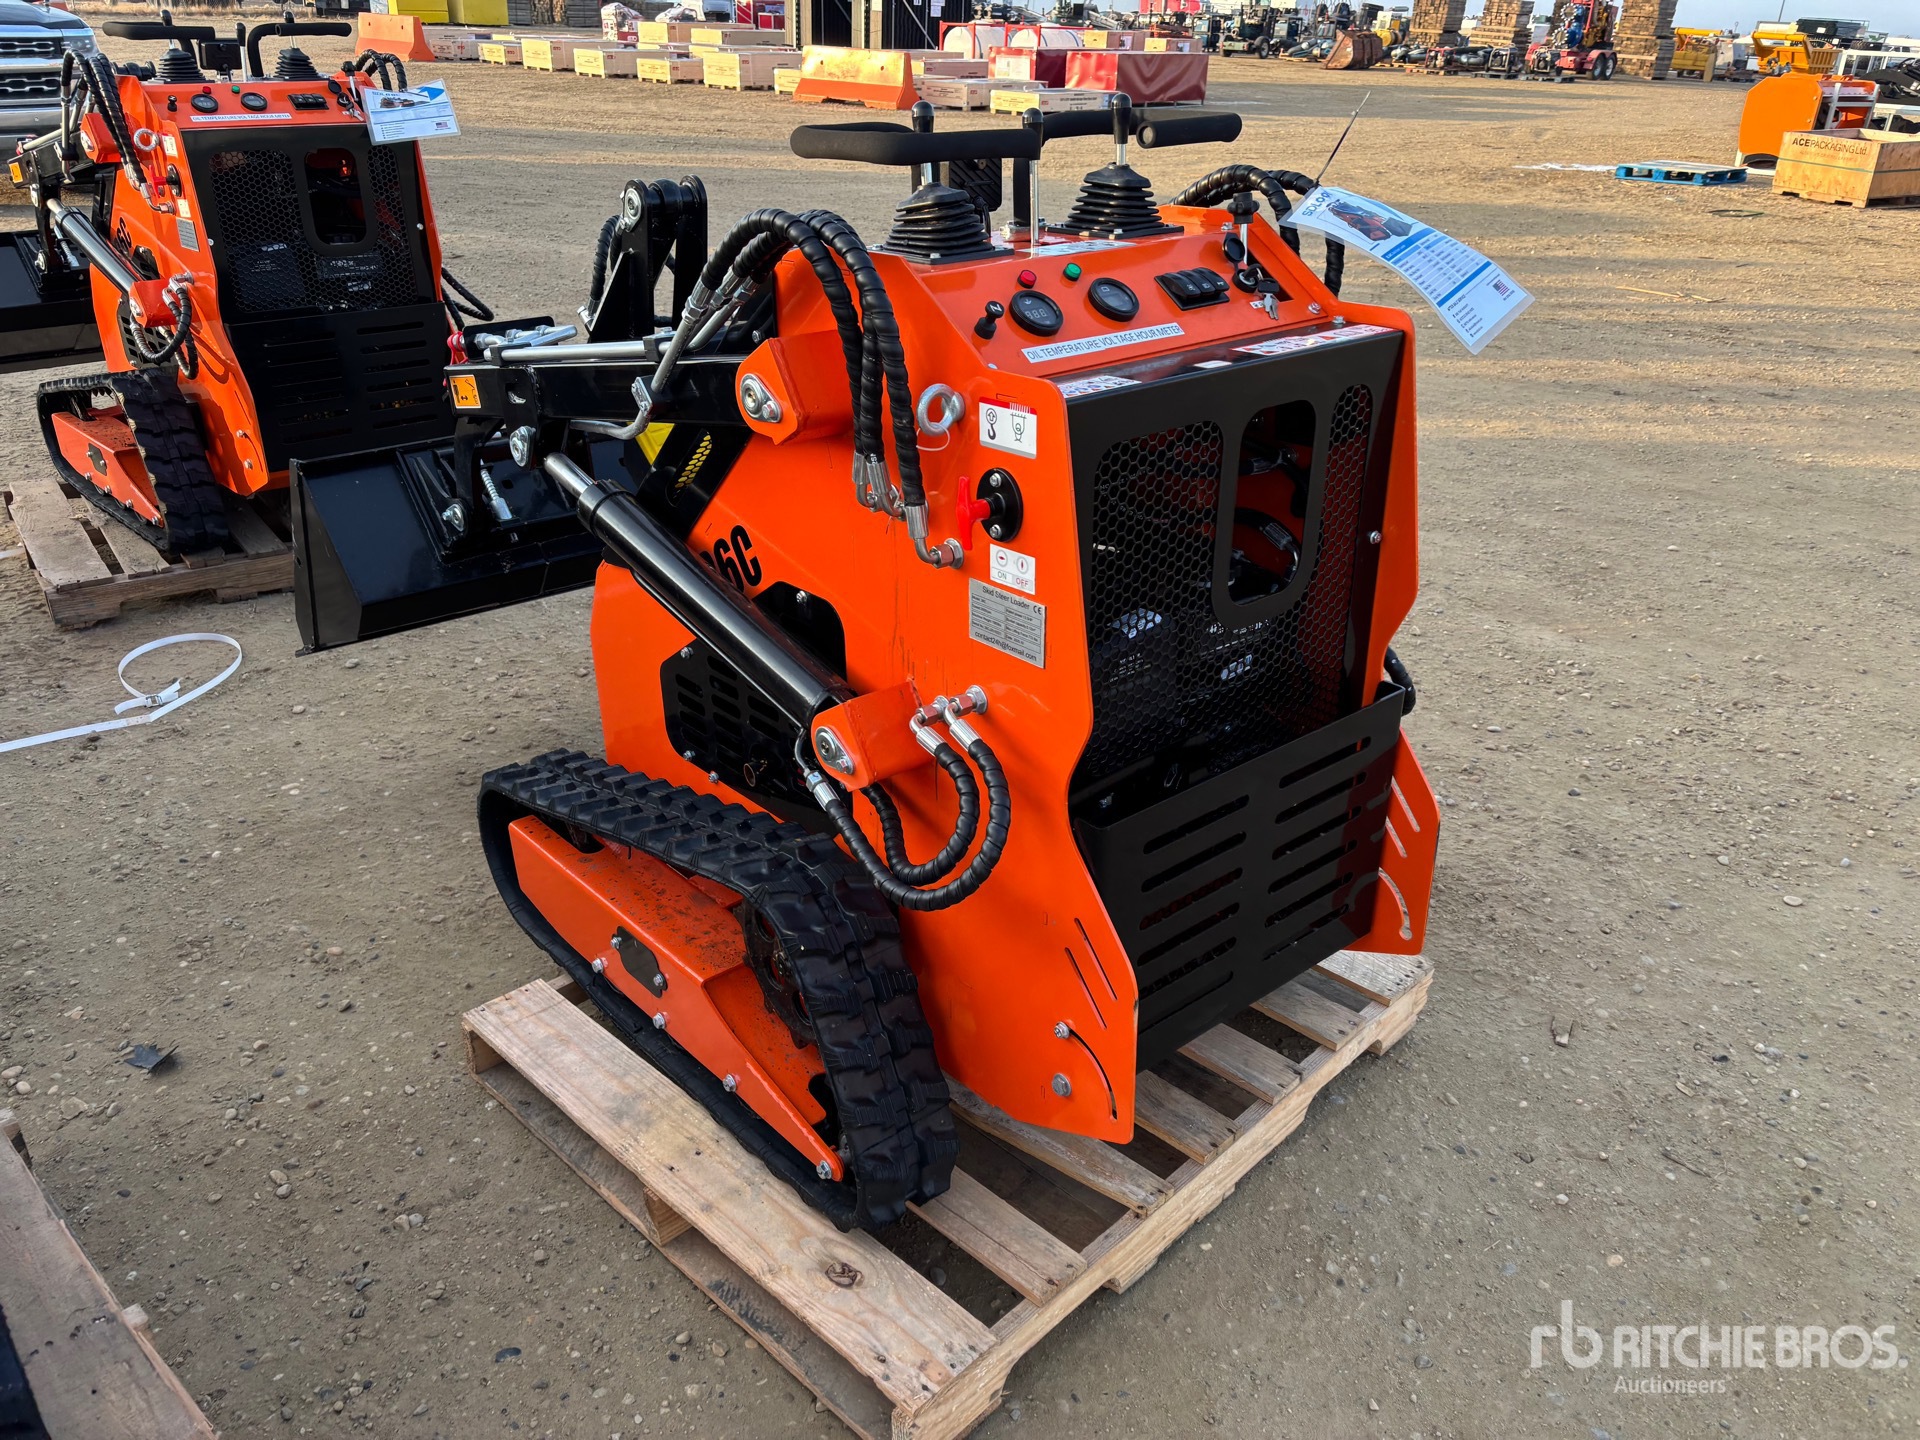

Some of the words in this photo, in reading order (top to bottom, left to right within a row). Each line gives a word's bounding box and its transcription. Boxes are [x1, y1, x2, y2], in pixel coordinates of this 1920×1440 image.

[1027, 350, 1042, 360] OIL
[1042, 339, 1101, 357] TEMPERATURE
[1099, 333, 1136, 349] VOLTAGE
[1136, 328, 1160, 340] HOUR
[1158, 325, 1184, 337] METER
[997, 570, 1007, 580] ON
[1016, 577, 1029, 587] OFF
[982, 585, 994, 596] Skid
[995, 591, 1010, 602] Steer
[1010, 596, 1030, 610] Loader
